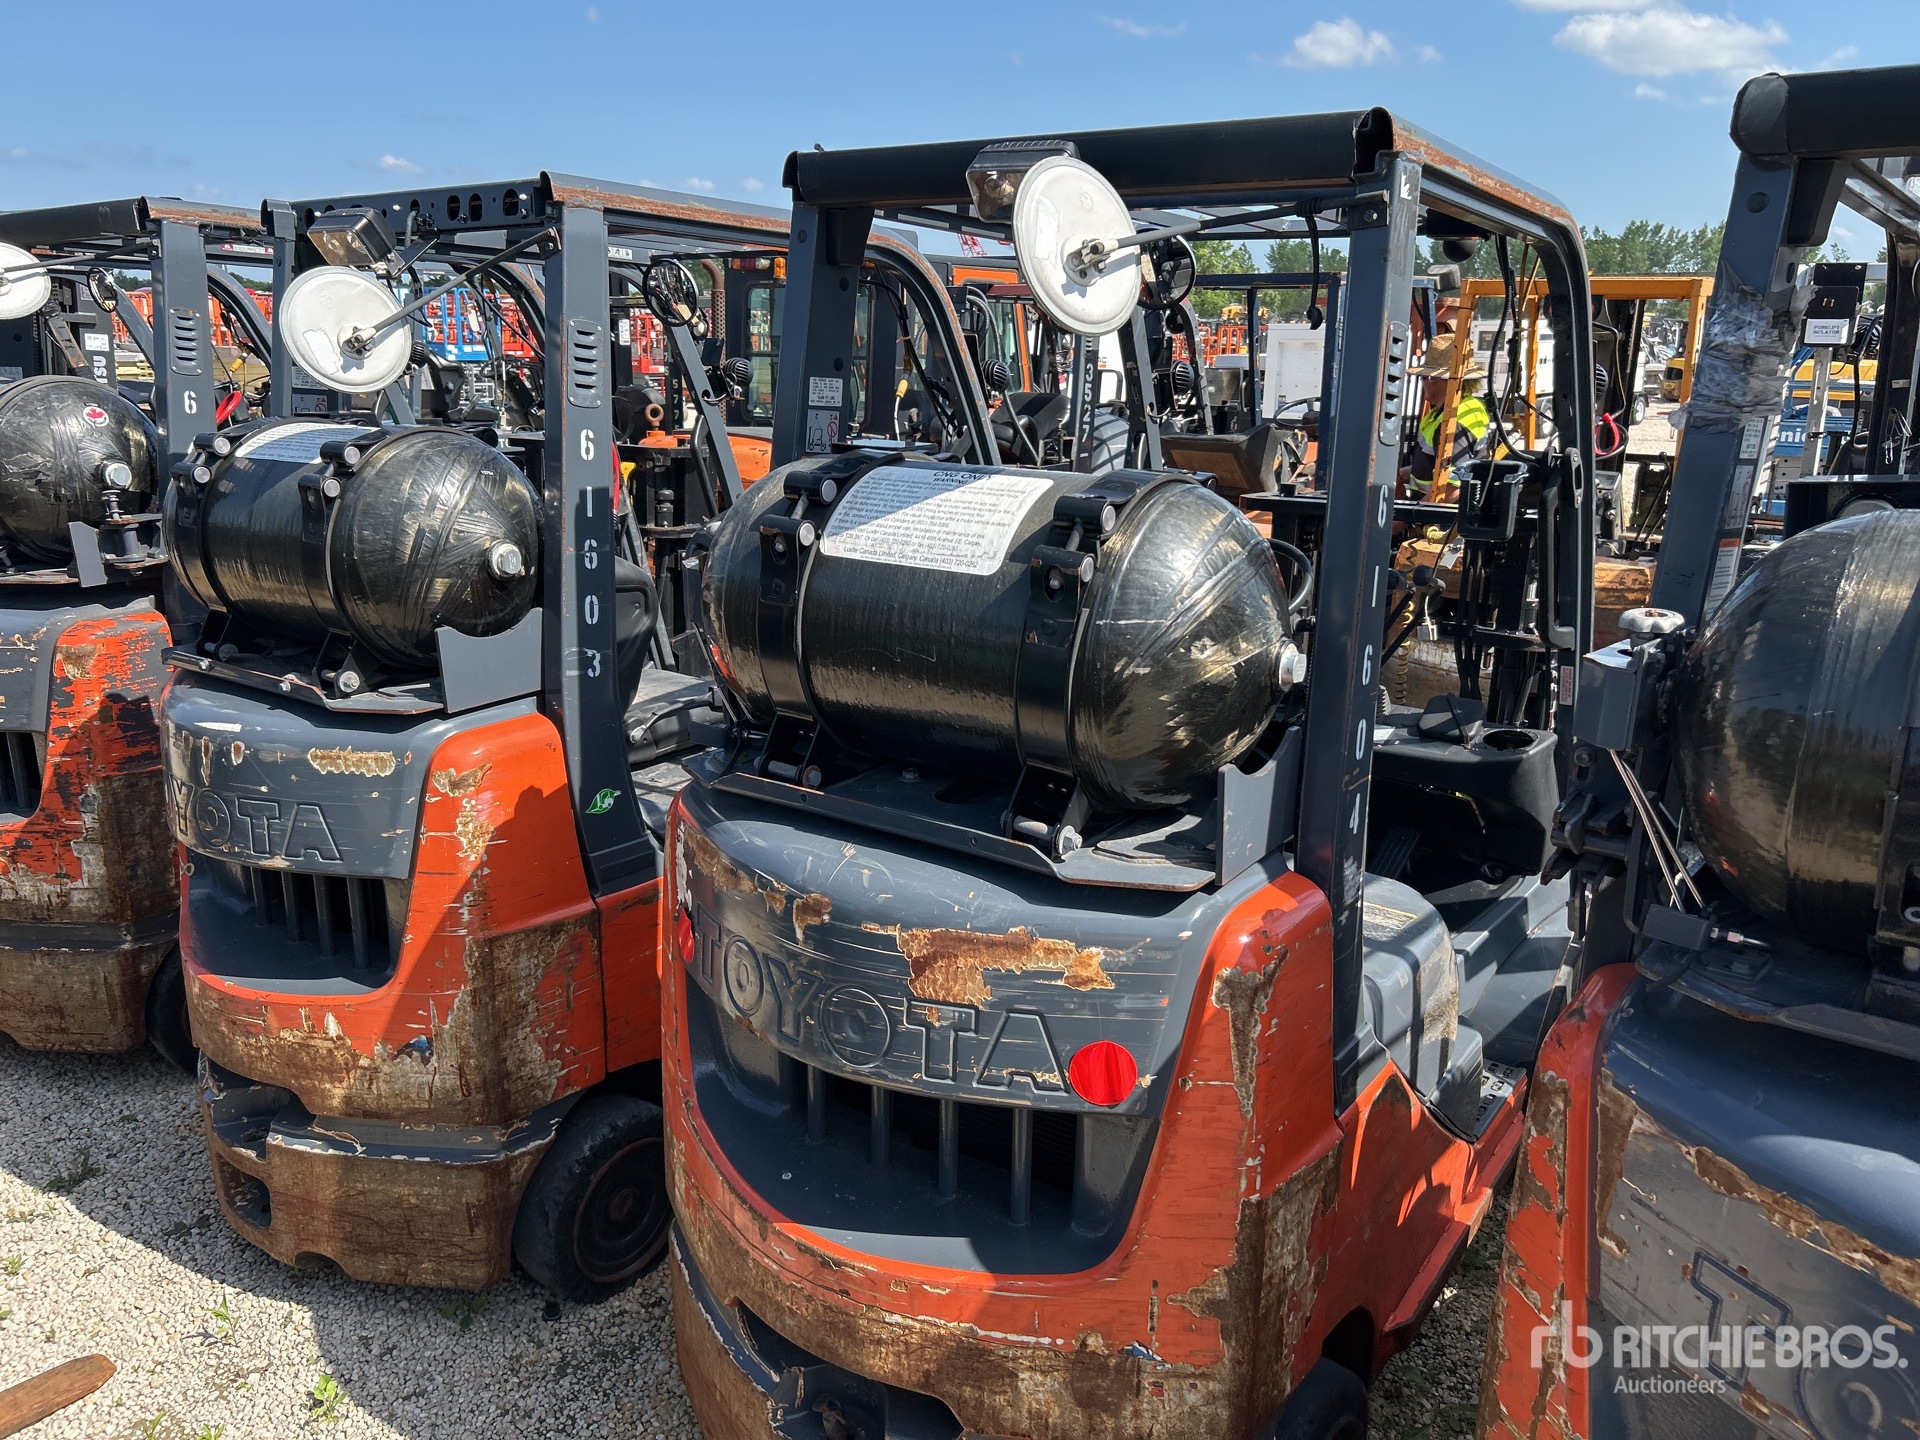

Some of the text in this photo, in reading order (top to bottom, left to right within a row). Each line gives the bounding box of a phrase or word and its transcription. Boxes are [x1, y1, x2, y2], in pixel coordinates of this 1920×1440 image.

[184, 390, 197, 415] 6
[580, 428, 601, 678] 61603
[843, 545, 859, 553] Luxfer
[859, 547, 879, 556] Canada
[919, 555, 940, 564] Canada
[940, 557, 954, 565] (403)
[954, 559, 979, 568] 720-0262
[696, 902, 1070, 1094] TOYOTA
